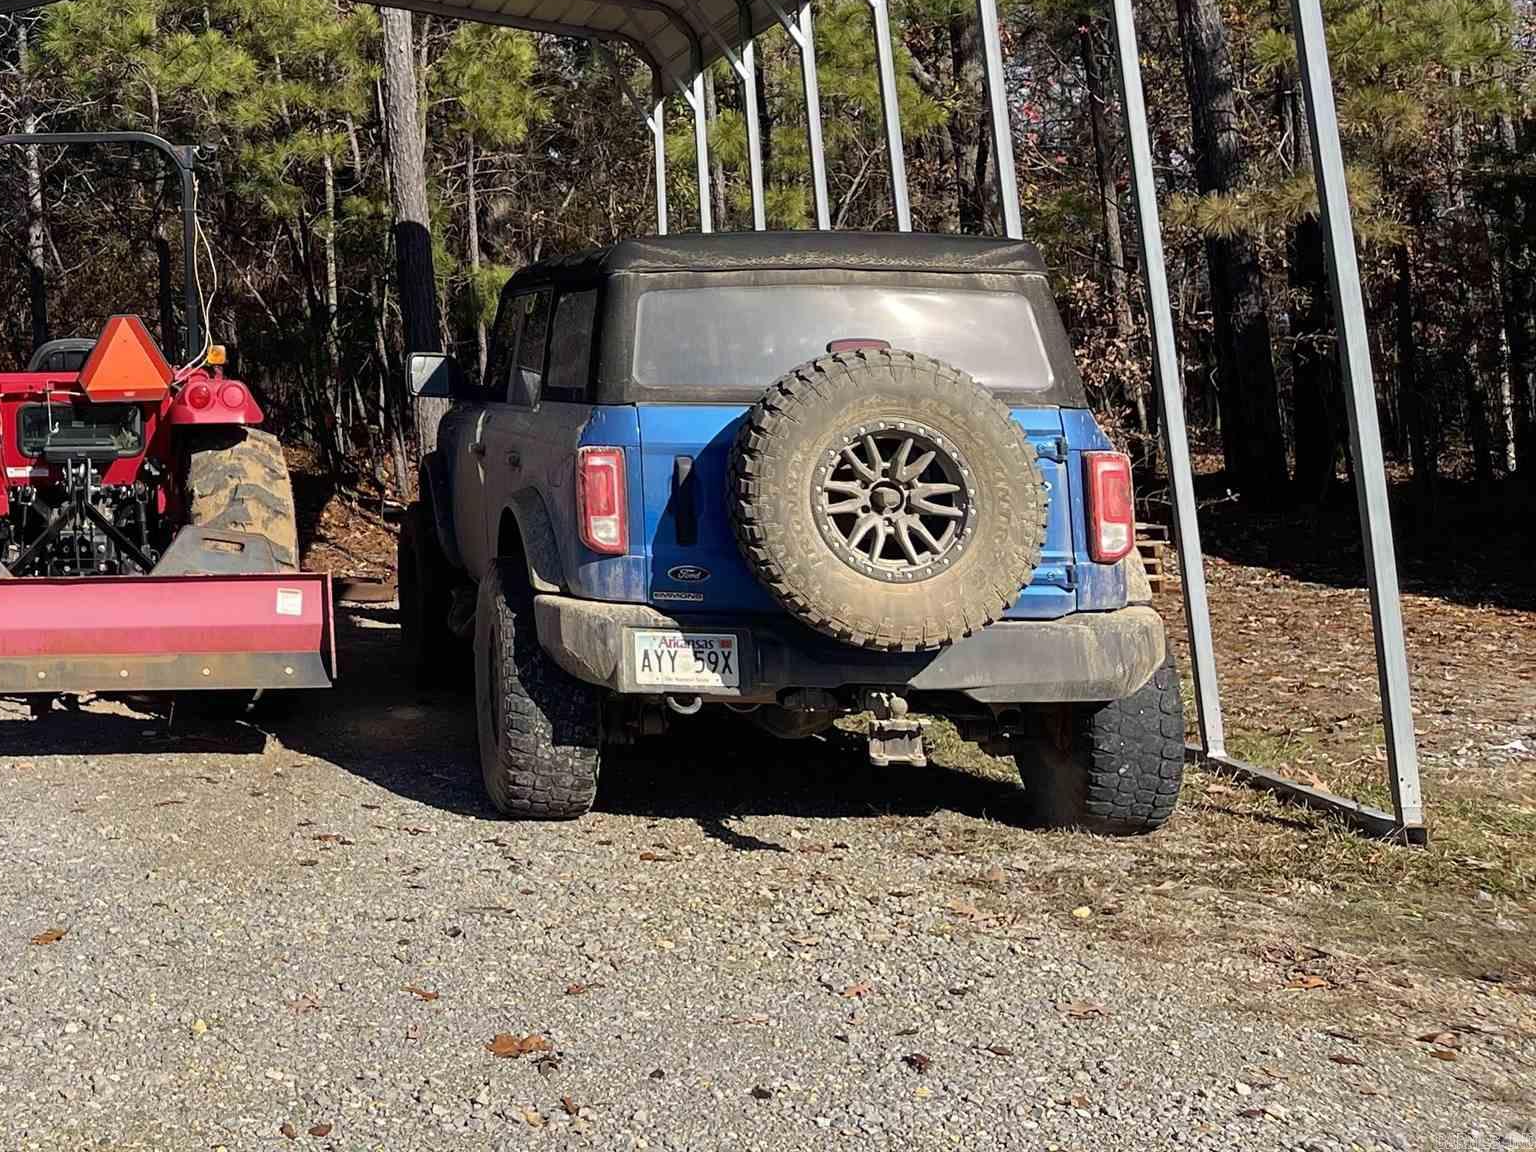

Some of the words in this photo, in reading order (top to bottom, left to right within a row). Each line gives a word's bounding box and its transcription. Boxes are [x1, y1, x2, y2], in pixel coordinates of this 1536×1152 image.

[658, 634, 714, 650] Arkansas
[641, 649, 678, 673] AYY
[694, 650, 733, 675] 59X
